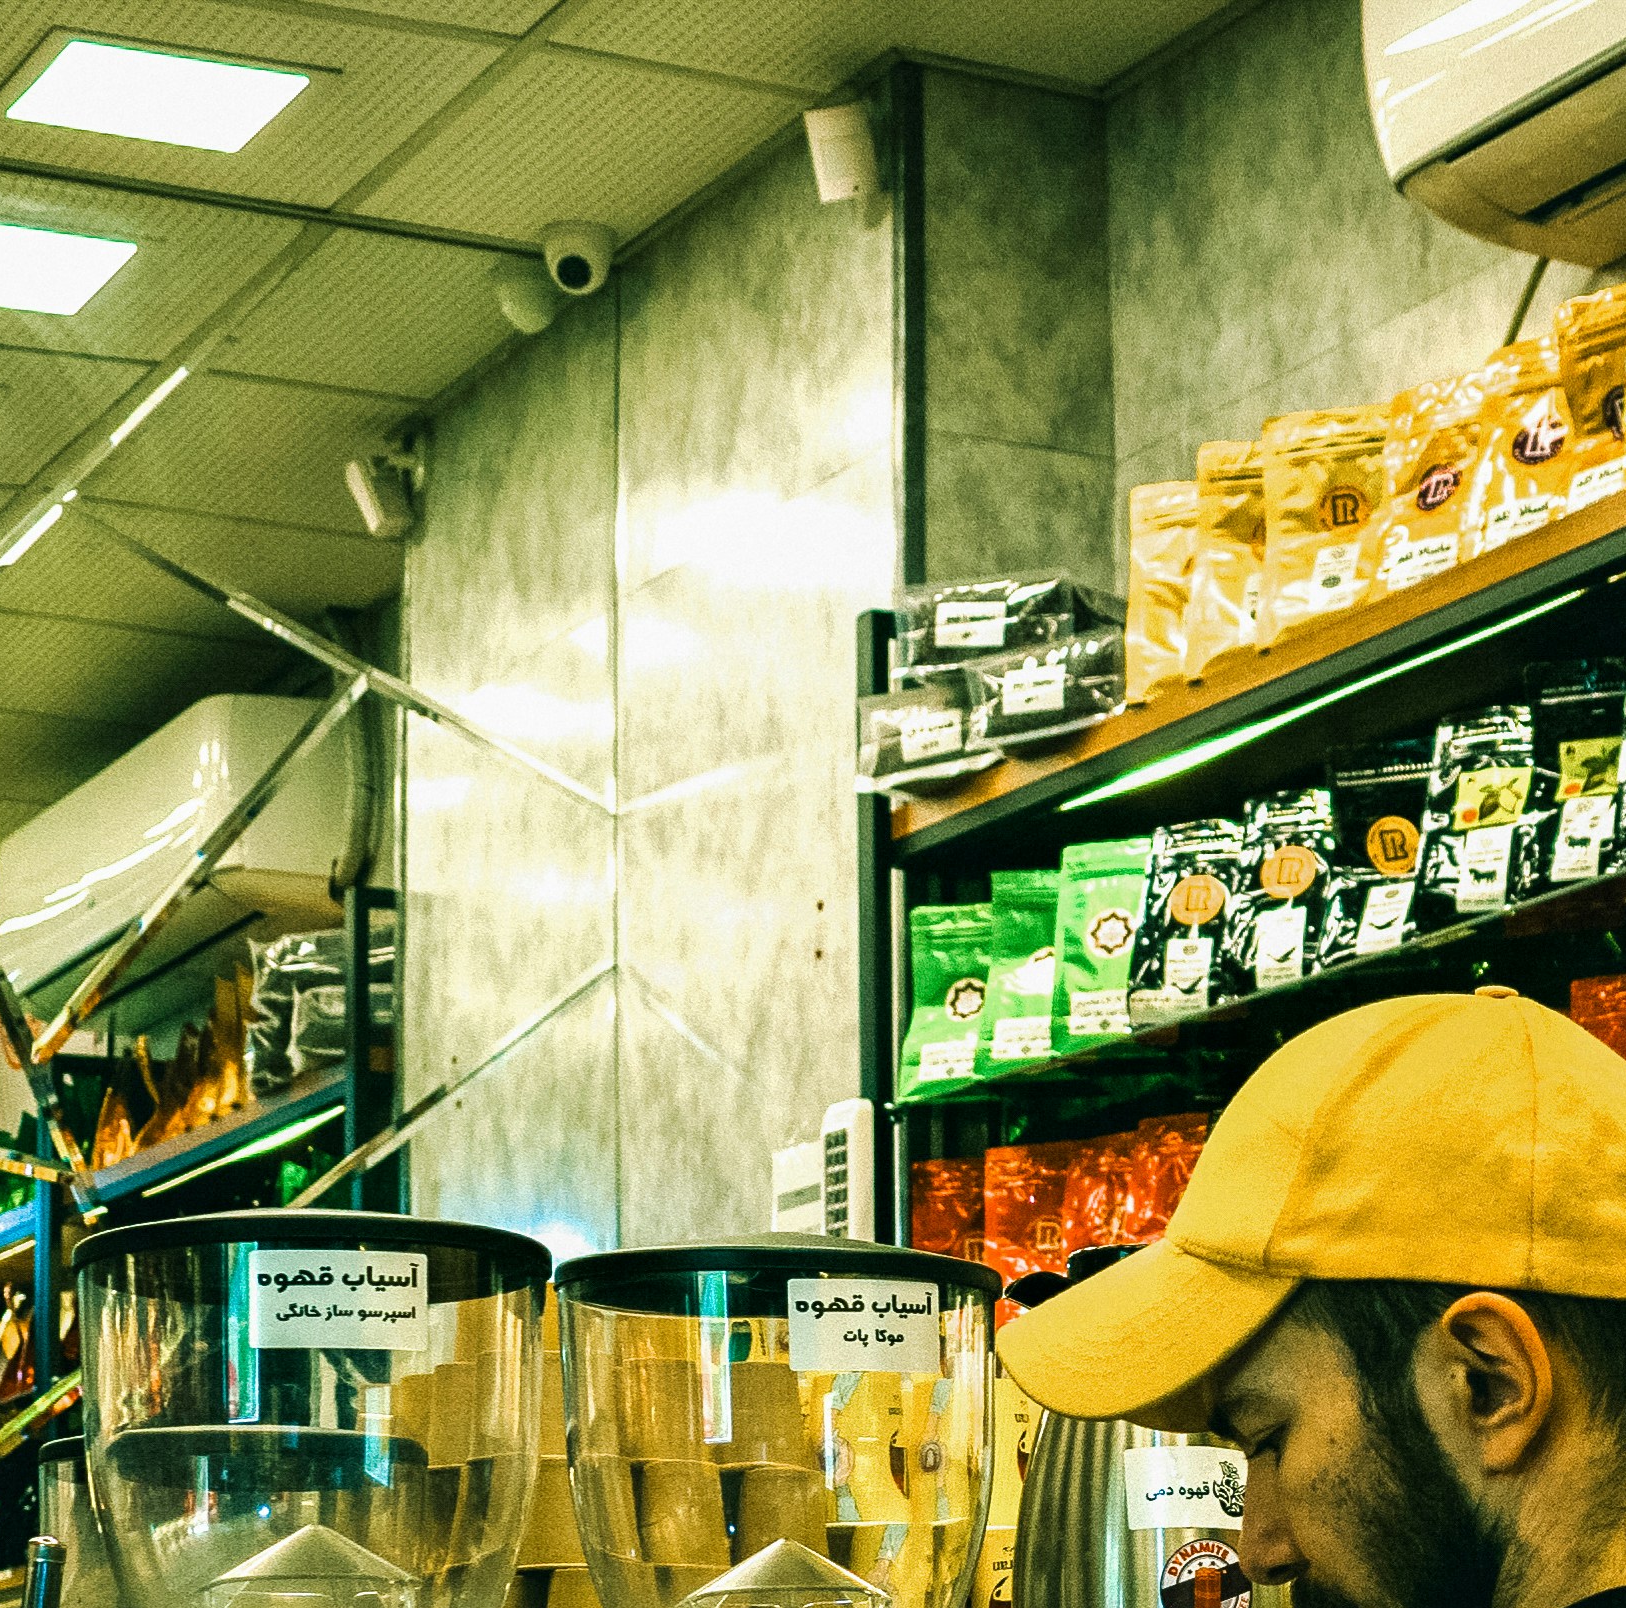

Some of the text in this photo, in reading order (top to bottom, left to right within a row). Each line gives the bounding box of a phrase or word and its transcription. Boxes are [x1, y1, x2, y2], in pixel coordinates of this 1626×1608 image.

[257, 1262, 419, 1293] آسیاب قهوه
[276, 1303, 416, 1323] اسپرسو ساز خانگی
[795, 1292, 933, 1319] آسیاب قهوه
[843, 1329, 904, 1347] موکا پات
[1145, 1481, 1210, 1501] قهوه دمی
[1167, 1541, 1230, 1577] DYNAMITE
